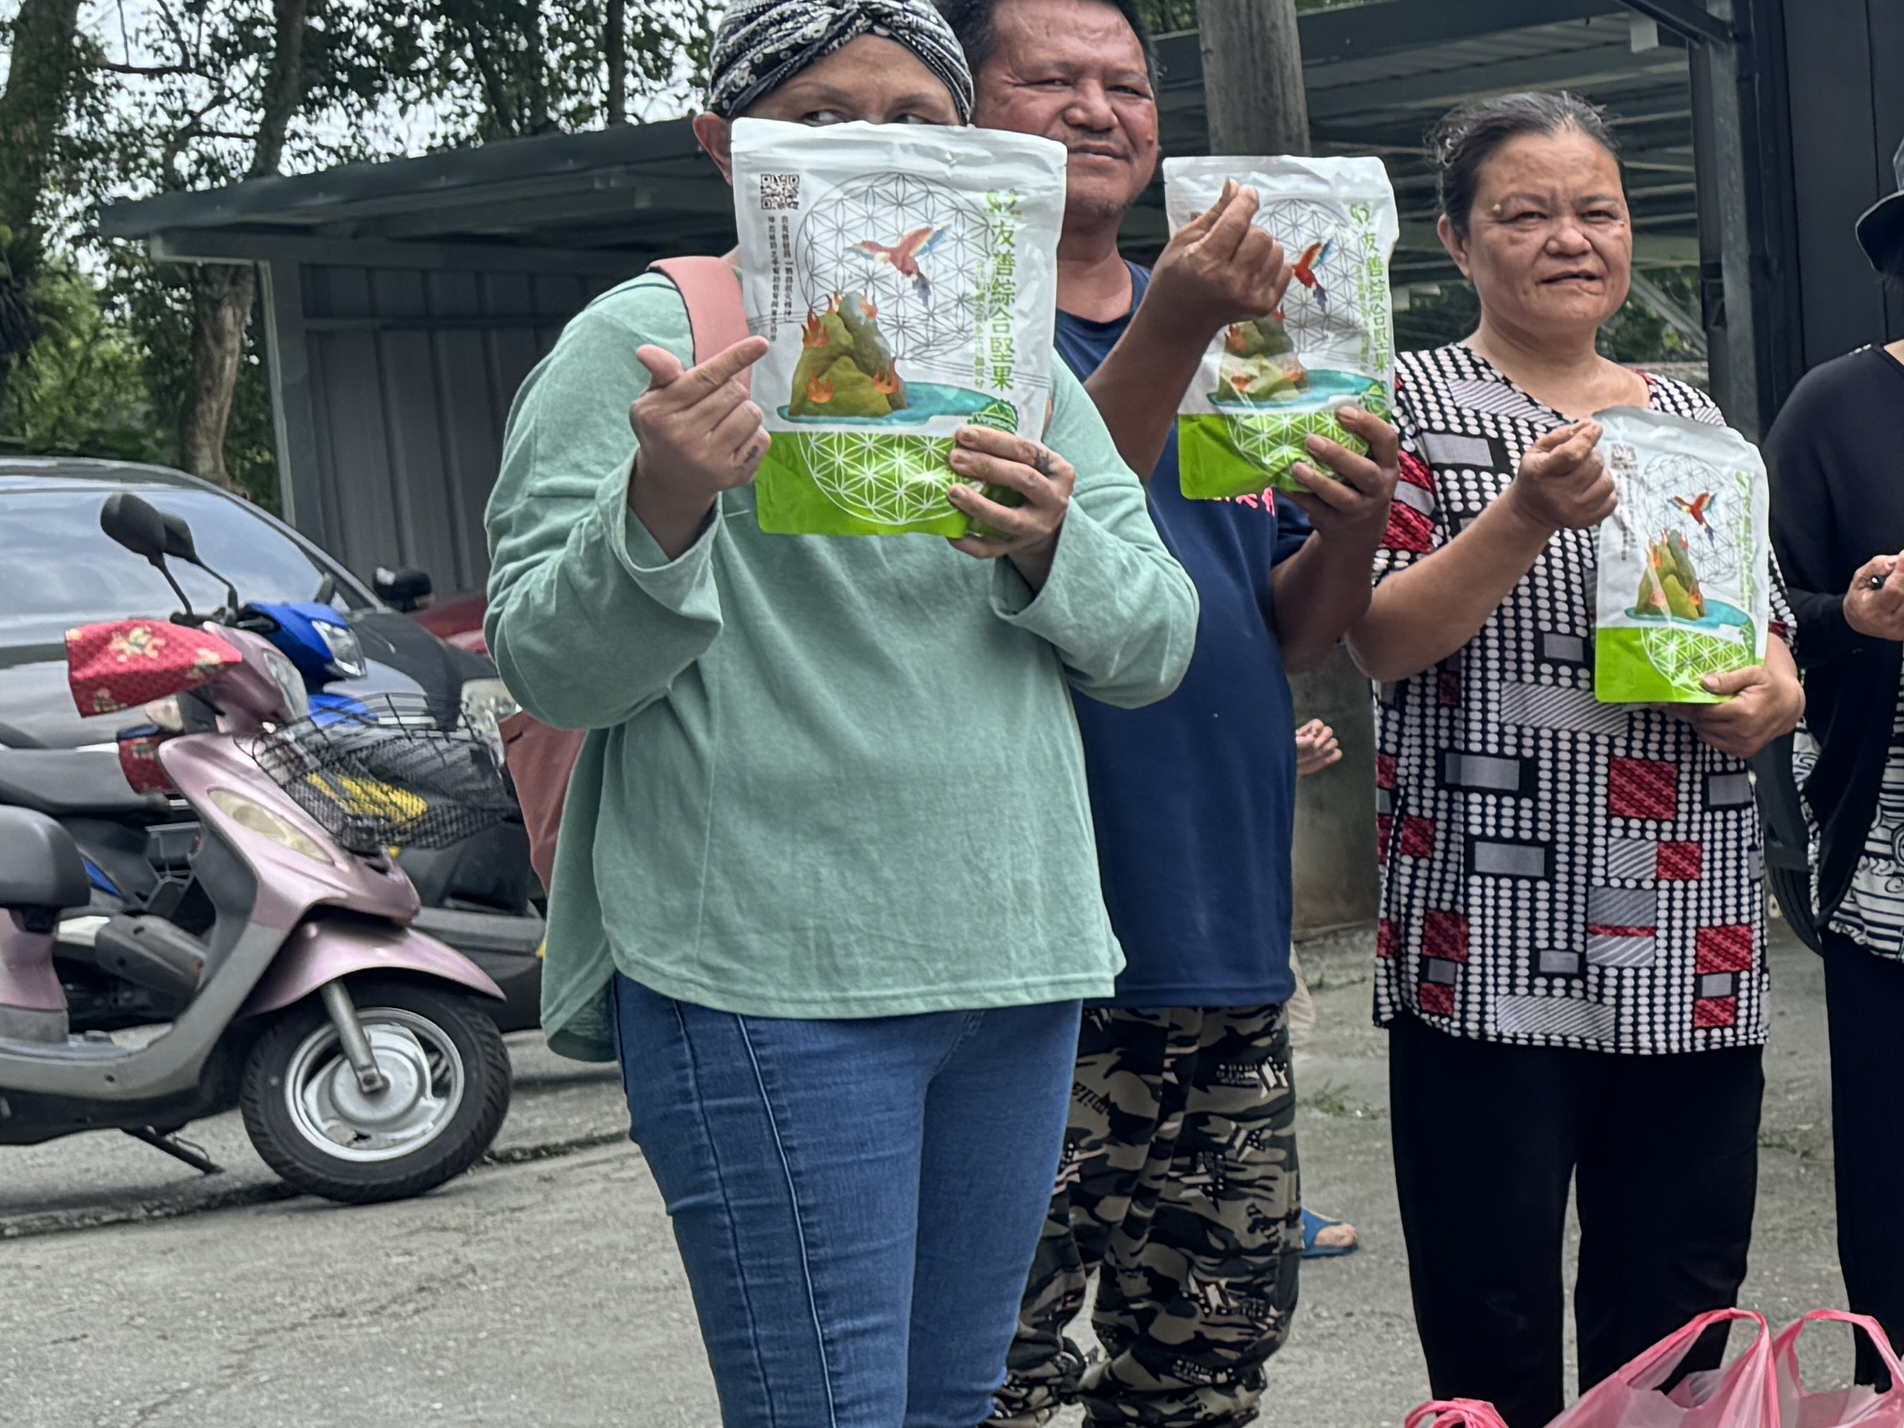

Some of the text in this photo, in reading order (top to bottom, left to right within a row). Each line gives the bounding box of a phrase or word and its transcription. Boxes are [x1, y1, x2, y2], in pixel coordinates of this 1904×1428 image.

[990, 220, 1016, 391] 友善綜合堅果
